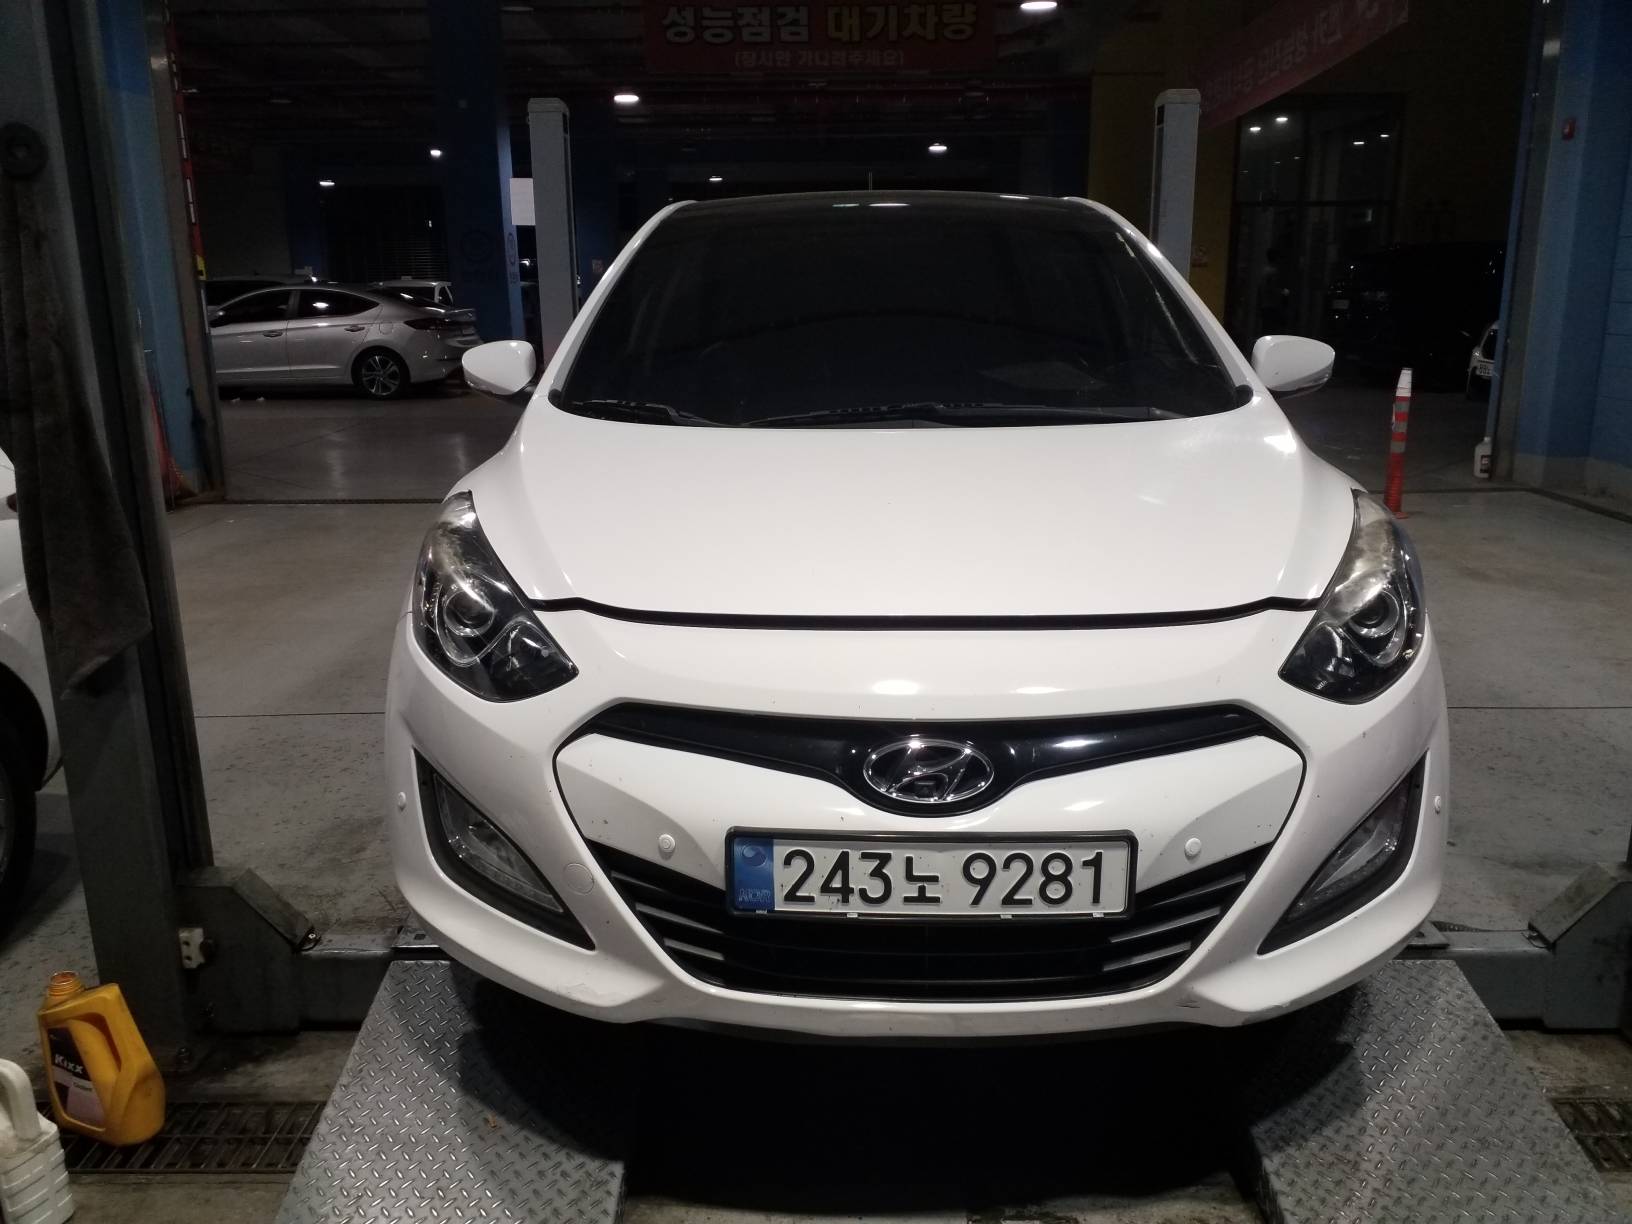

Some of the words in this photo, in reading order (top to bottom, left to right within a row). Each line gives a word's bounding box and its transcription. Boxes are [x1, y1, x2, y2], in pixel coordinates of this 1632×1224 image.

[662, 4, 809, 43] 성능점검
[826, 4, 977, 42] 대기차량
[783, 848, 941, 905] 243노
[962, 850, 1103, 906] 9281
[55, 1054, 83, 1074] Kixx
